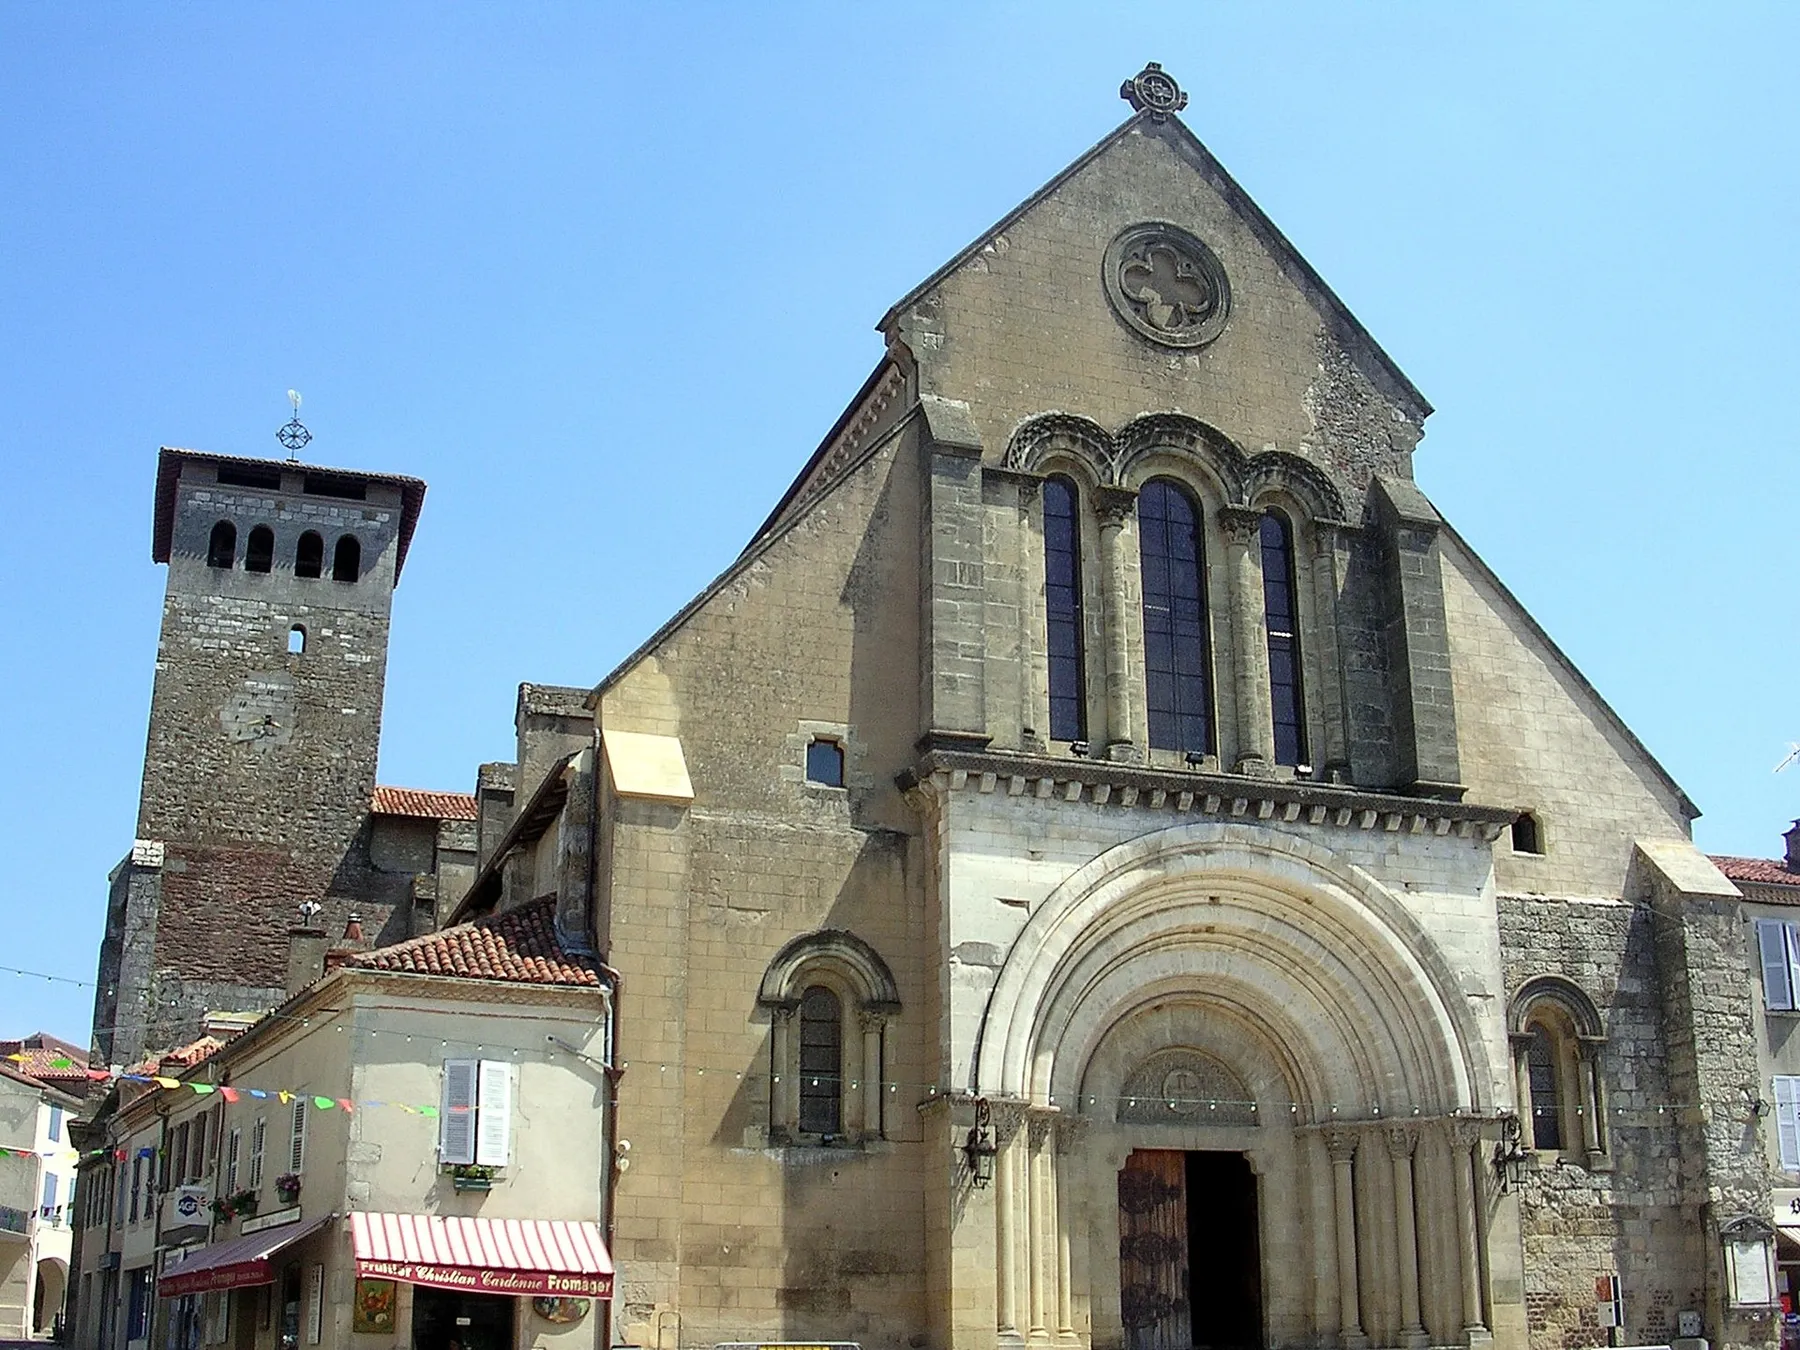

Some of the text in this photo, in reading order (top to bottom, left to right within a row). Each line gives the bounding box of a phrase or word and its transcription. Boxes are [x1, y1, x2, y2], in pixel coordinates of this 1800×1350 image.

[180, 1201, 198, 1212] AGF
[416, 1265, 476, 1286] Christian
[481, 1270, 543, 1290] Cardonne
[547, 1274, 612, 1295] Fromager
